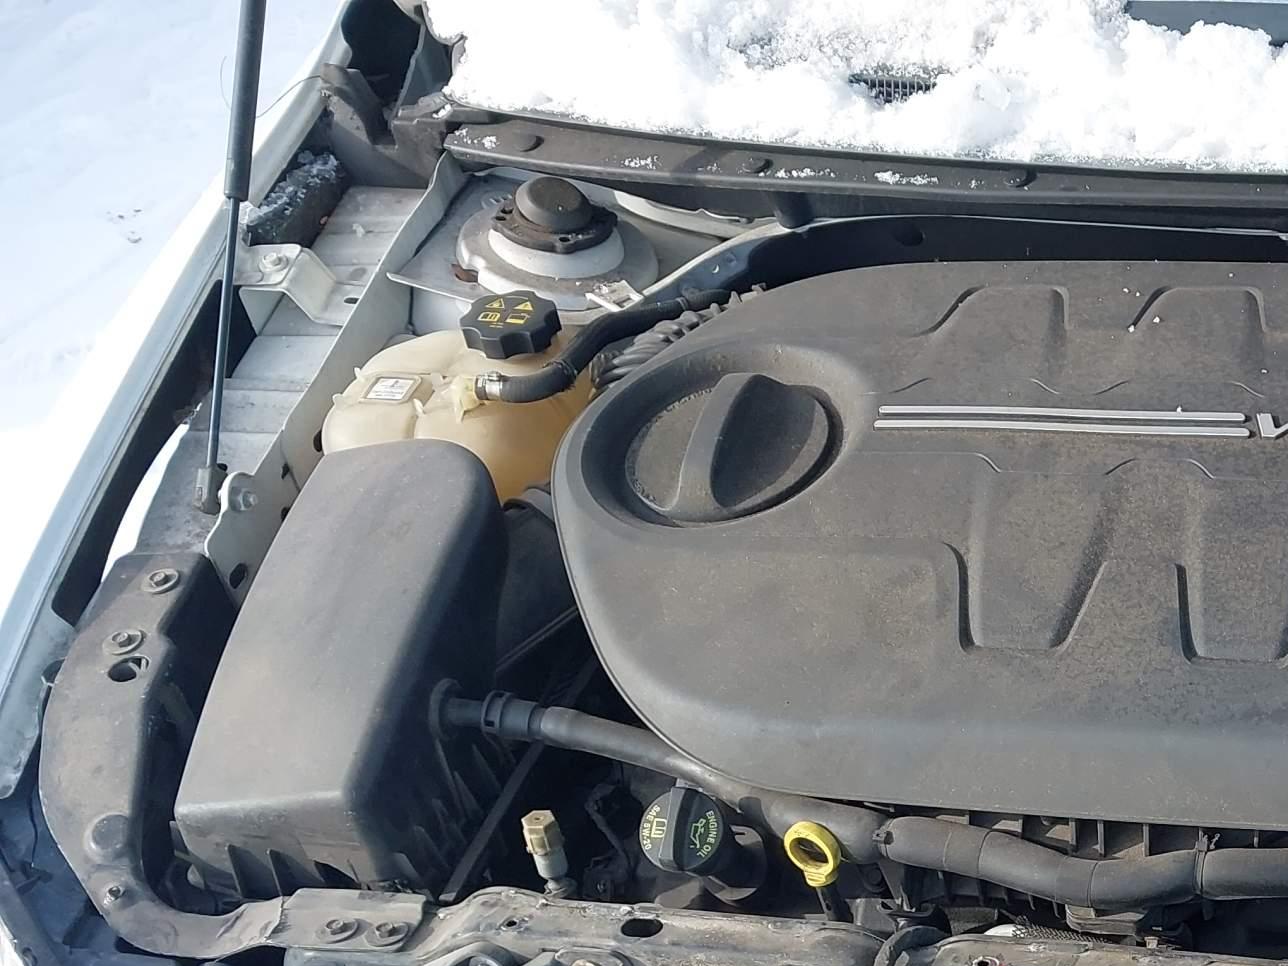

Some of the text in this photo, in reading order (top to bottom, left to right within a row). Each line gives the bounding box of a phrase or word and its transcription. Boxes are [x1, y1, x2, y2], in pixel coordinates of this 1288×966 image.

[646, 805, 661, 822] SAE
[696, 810, 718, 858] ENGINE OIL
